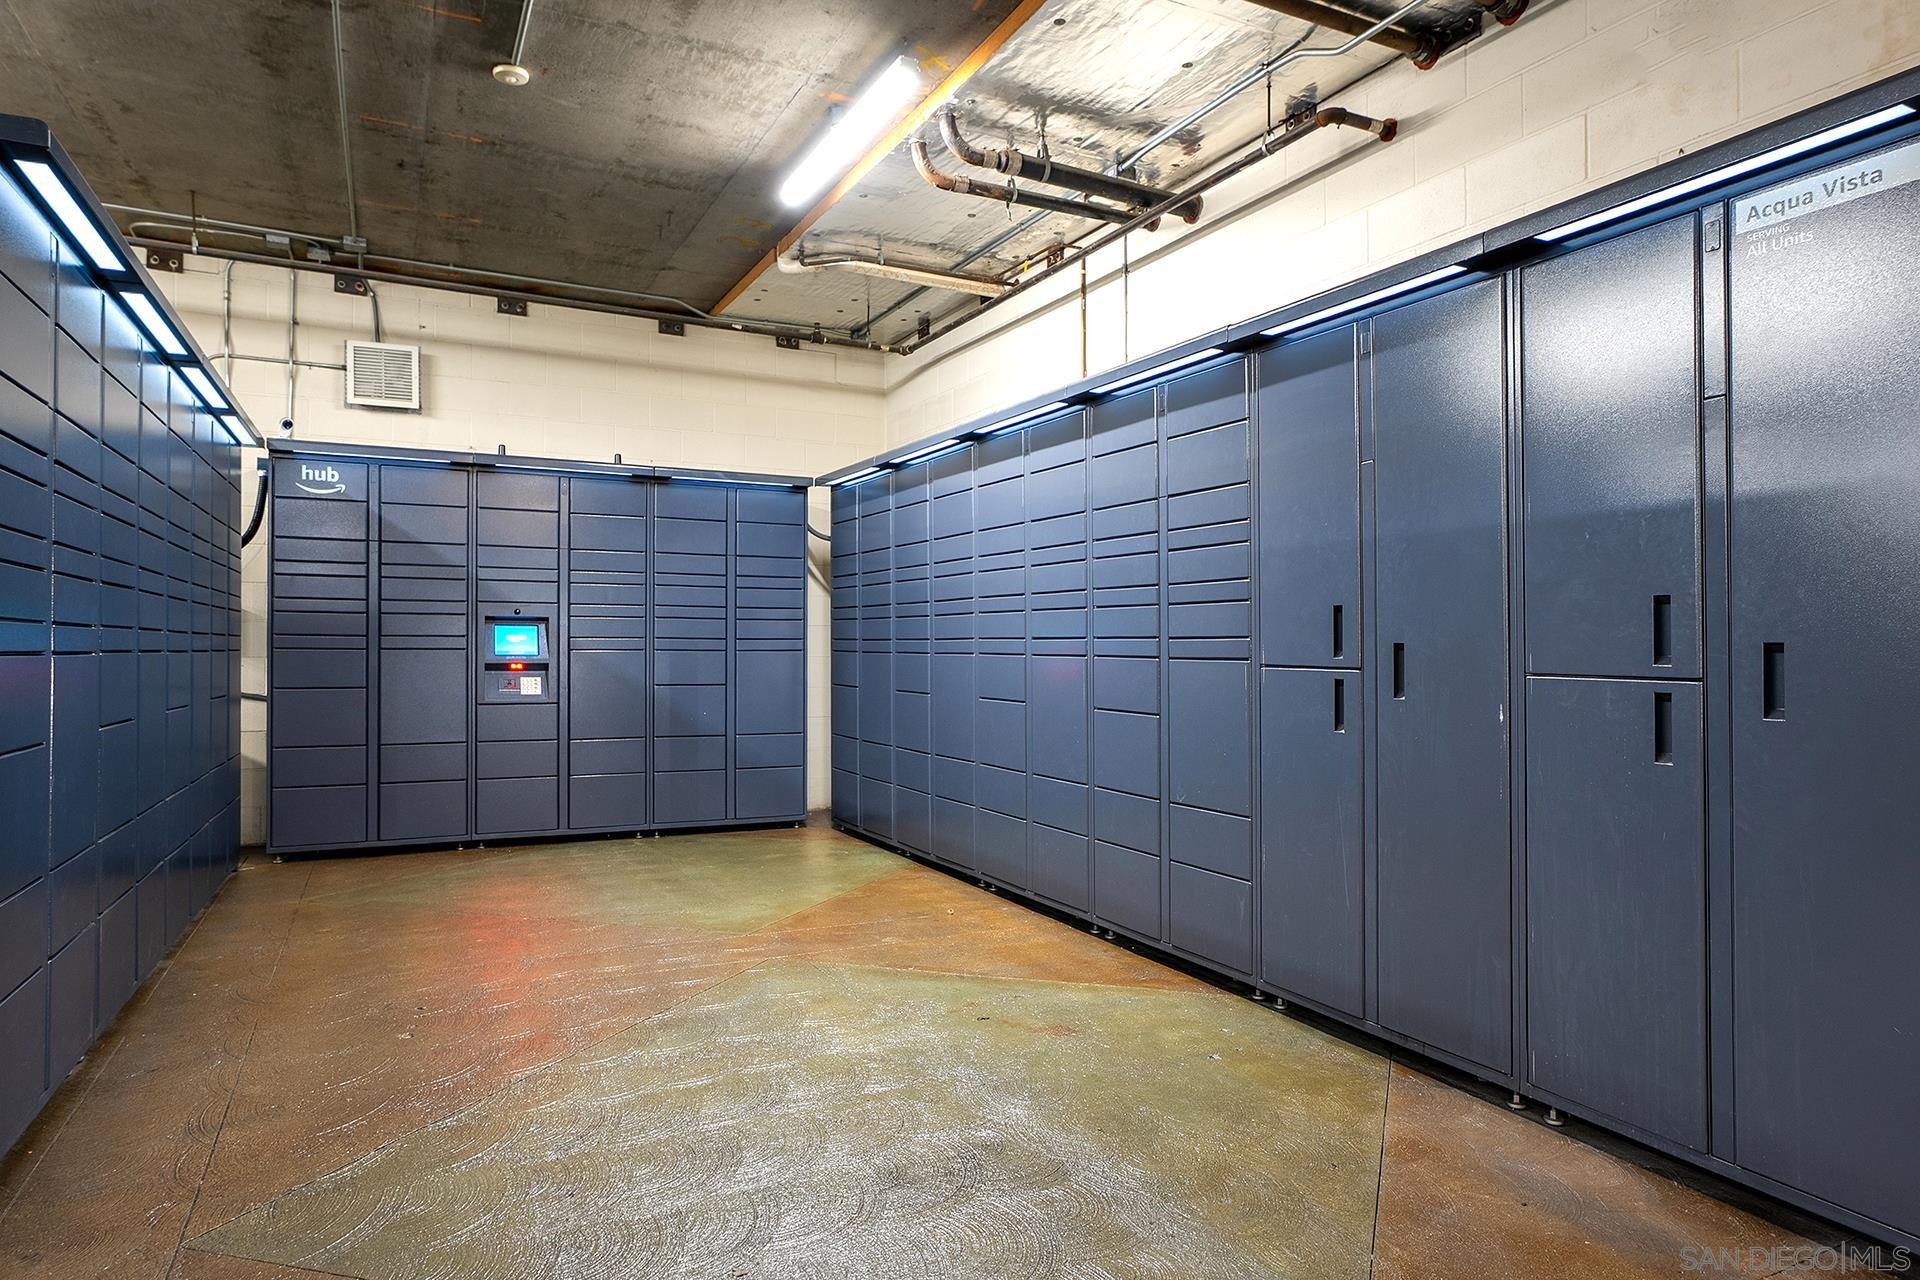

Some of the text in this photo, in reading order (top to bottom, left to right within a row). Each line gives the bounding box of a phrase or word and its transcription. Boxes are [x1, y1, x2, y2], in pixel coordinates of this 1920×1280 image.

[1746, 168, 1883, 224] Acqua Vista
[1746, 223, 1791, 243] SERVING
[1746, 230, 1814, 259] All Units
[301, 464, 340, 482] hub
